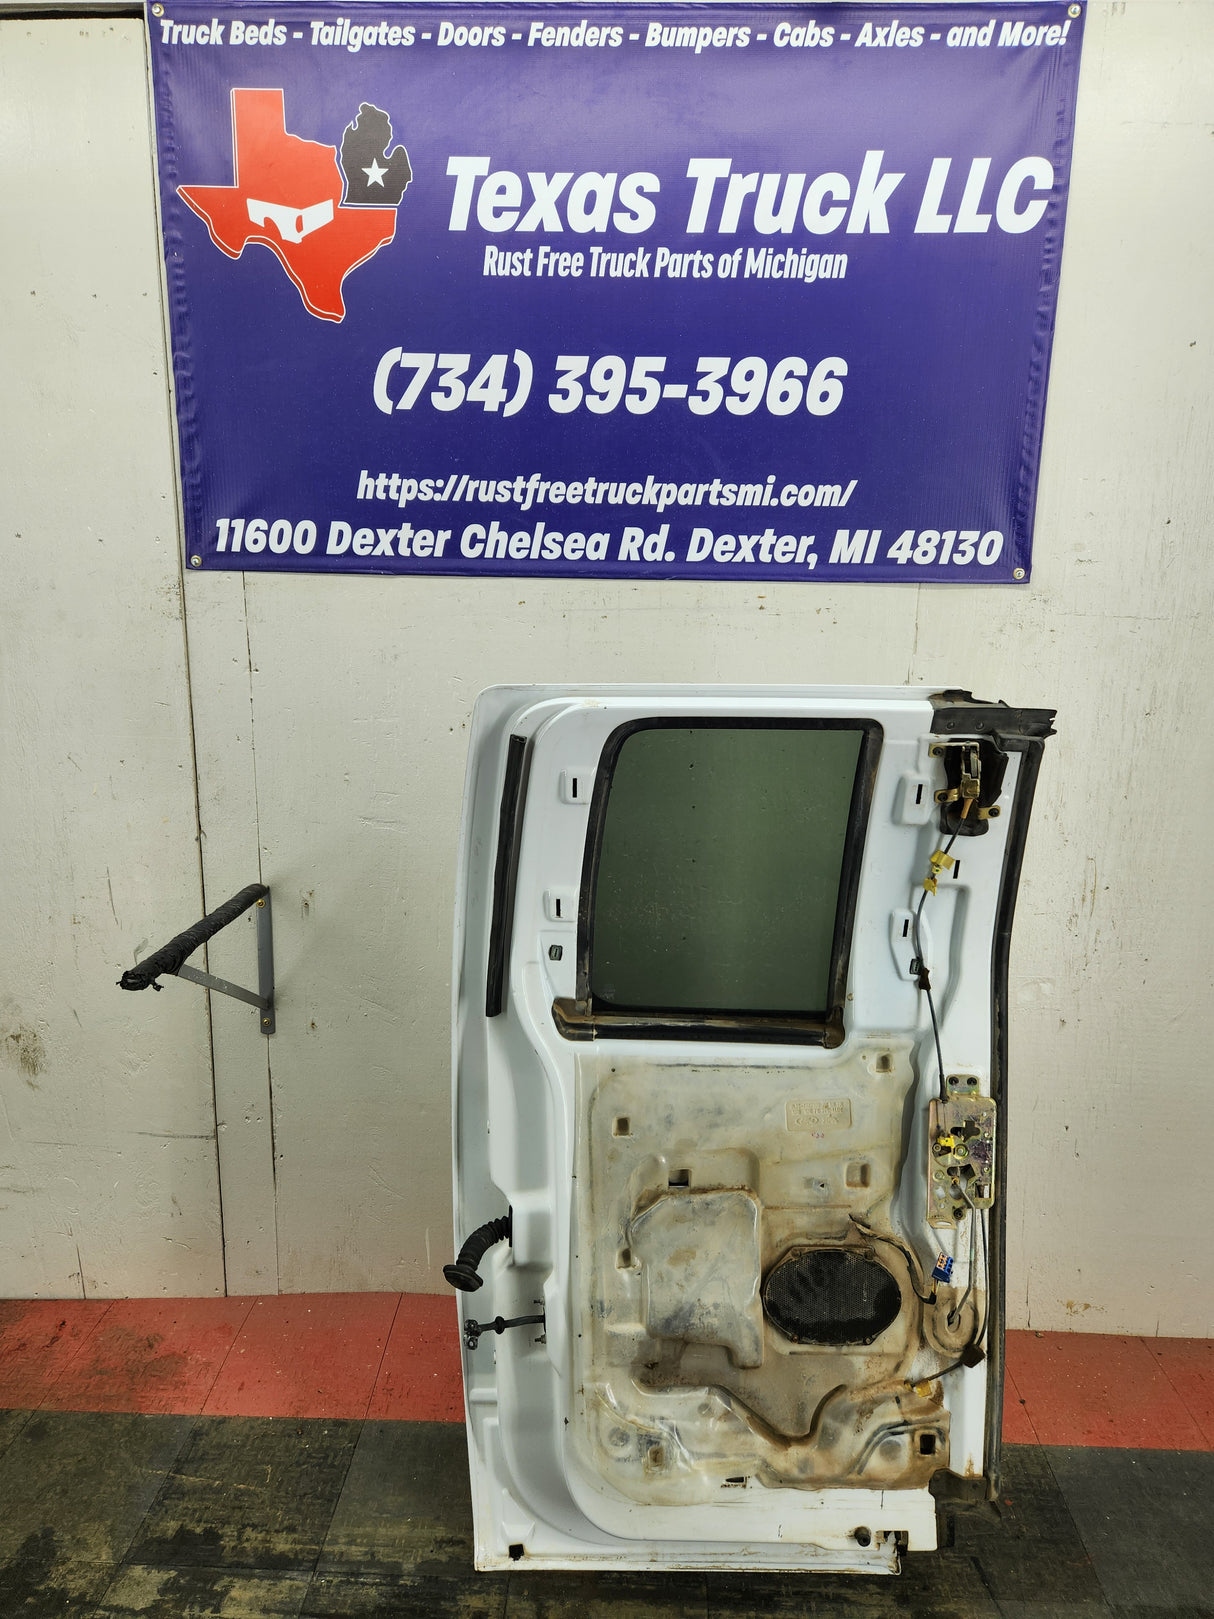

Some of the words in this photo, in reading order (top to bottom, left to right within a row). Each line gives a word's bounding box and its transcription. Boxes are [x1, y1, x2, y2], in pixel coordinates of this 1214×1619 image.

[160, 19, 225, 46] Truck
[230, 19, 287, 46] Beds
[310, 18, 415, 52] Tailgates
[437, 22, 506, 47] Doors
[527, 21, 623, 47] Fenders
[645, 23, 751, 54] Bumpers
[773, 20, 835, 48] Cabs
[854, 20, 924, 47] Axles
[946, 20, 992, 47] and
[997, 20, 1072, 47] More!
[446, 156, 660, 234] Texas
[686, 150, 905, 234] Truck
[914, 156, 1055, 234] LLC
[483, 246, 533, 276] Rust
[537, 246, 585, 277] Free
[589, 247, 651, 278] Truck
[654, 247, 714, 278] Parts
[717, 247, 742, 278] of
[743, 248, 848, 282] Michigan
[373, 346, 532, 417] (734)
[548, 356, 848, 416] 395-3966
[356, 469, 858, 512] https://rustfreetruckpartsmi.com/
[215, 518, 317, 555] 11600
[326, 521, 451, 558] Dexter
[460, 521, 610, 561] Chelsea
[617, 524, 675, 562] Rd.
[685, 528, 817, 569] Dexter,
[828, 529, 881, 564] MI
[887, 530, 1004, 566] 48130
